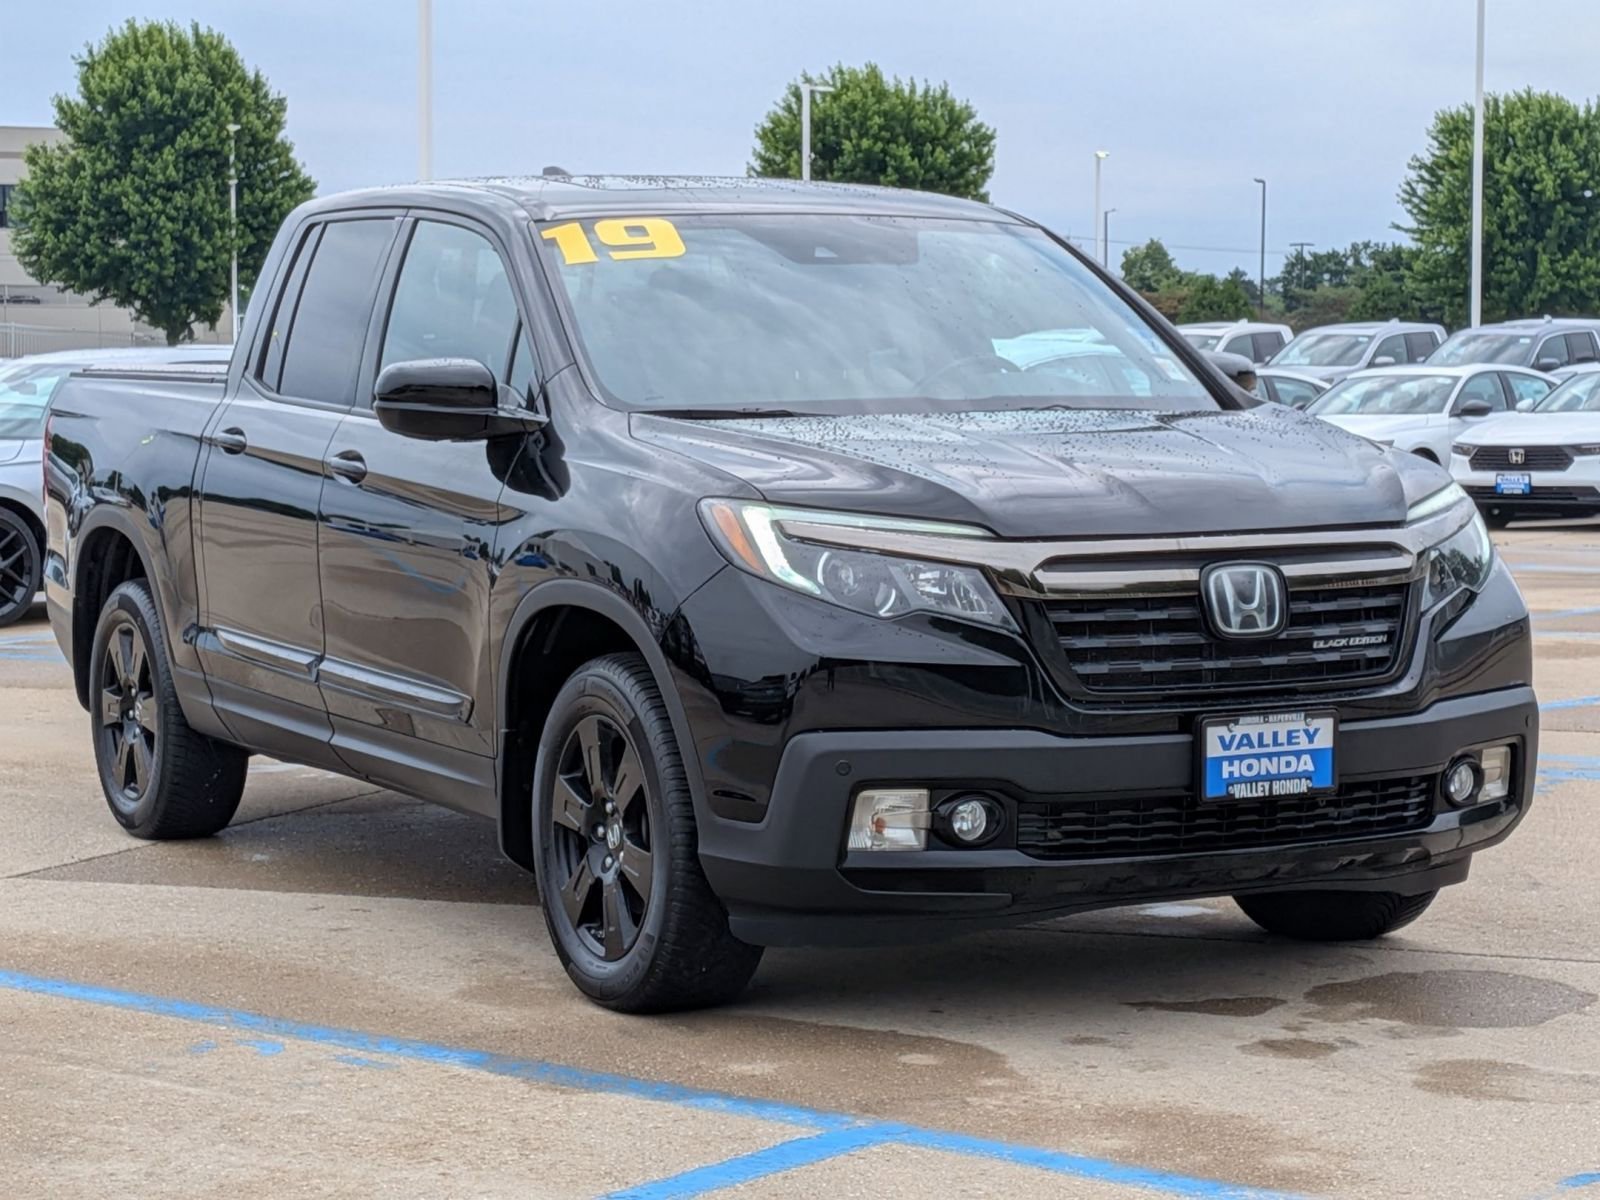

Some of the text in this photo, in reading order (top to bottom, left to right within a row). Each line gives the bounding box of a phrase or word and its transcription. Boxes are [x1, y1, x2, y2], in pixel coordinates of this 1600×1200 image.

[541, 218, 686, 265] 19
[1217, 728, 1321, 751] VALLEY
[1222, 754, 1315, 779] HONDA
[1234, 777, 1308, 799] VALLEY HONDA
